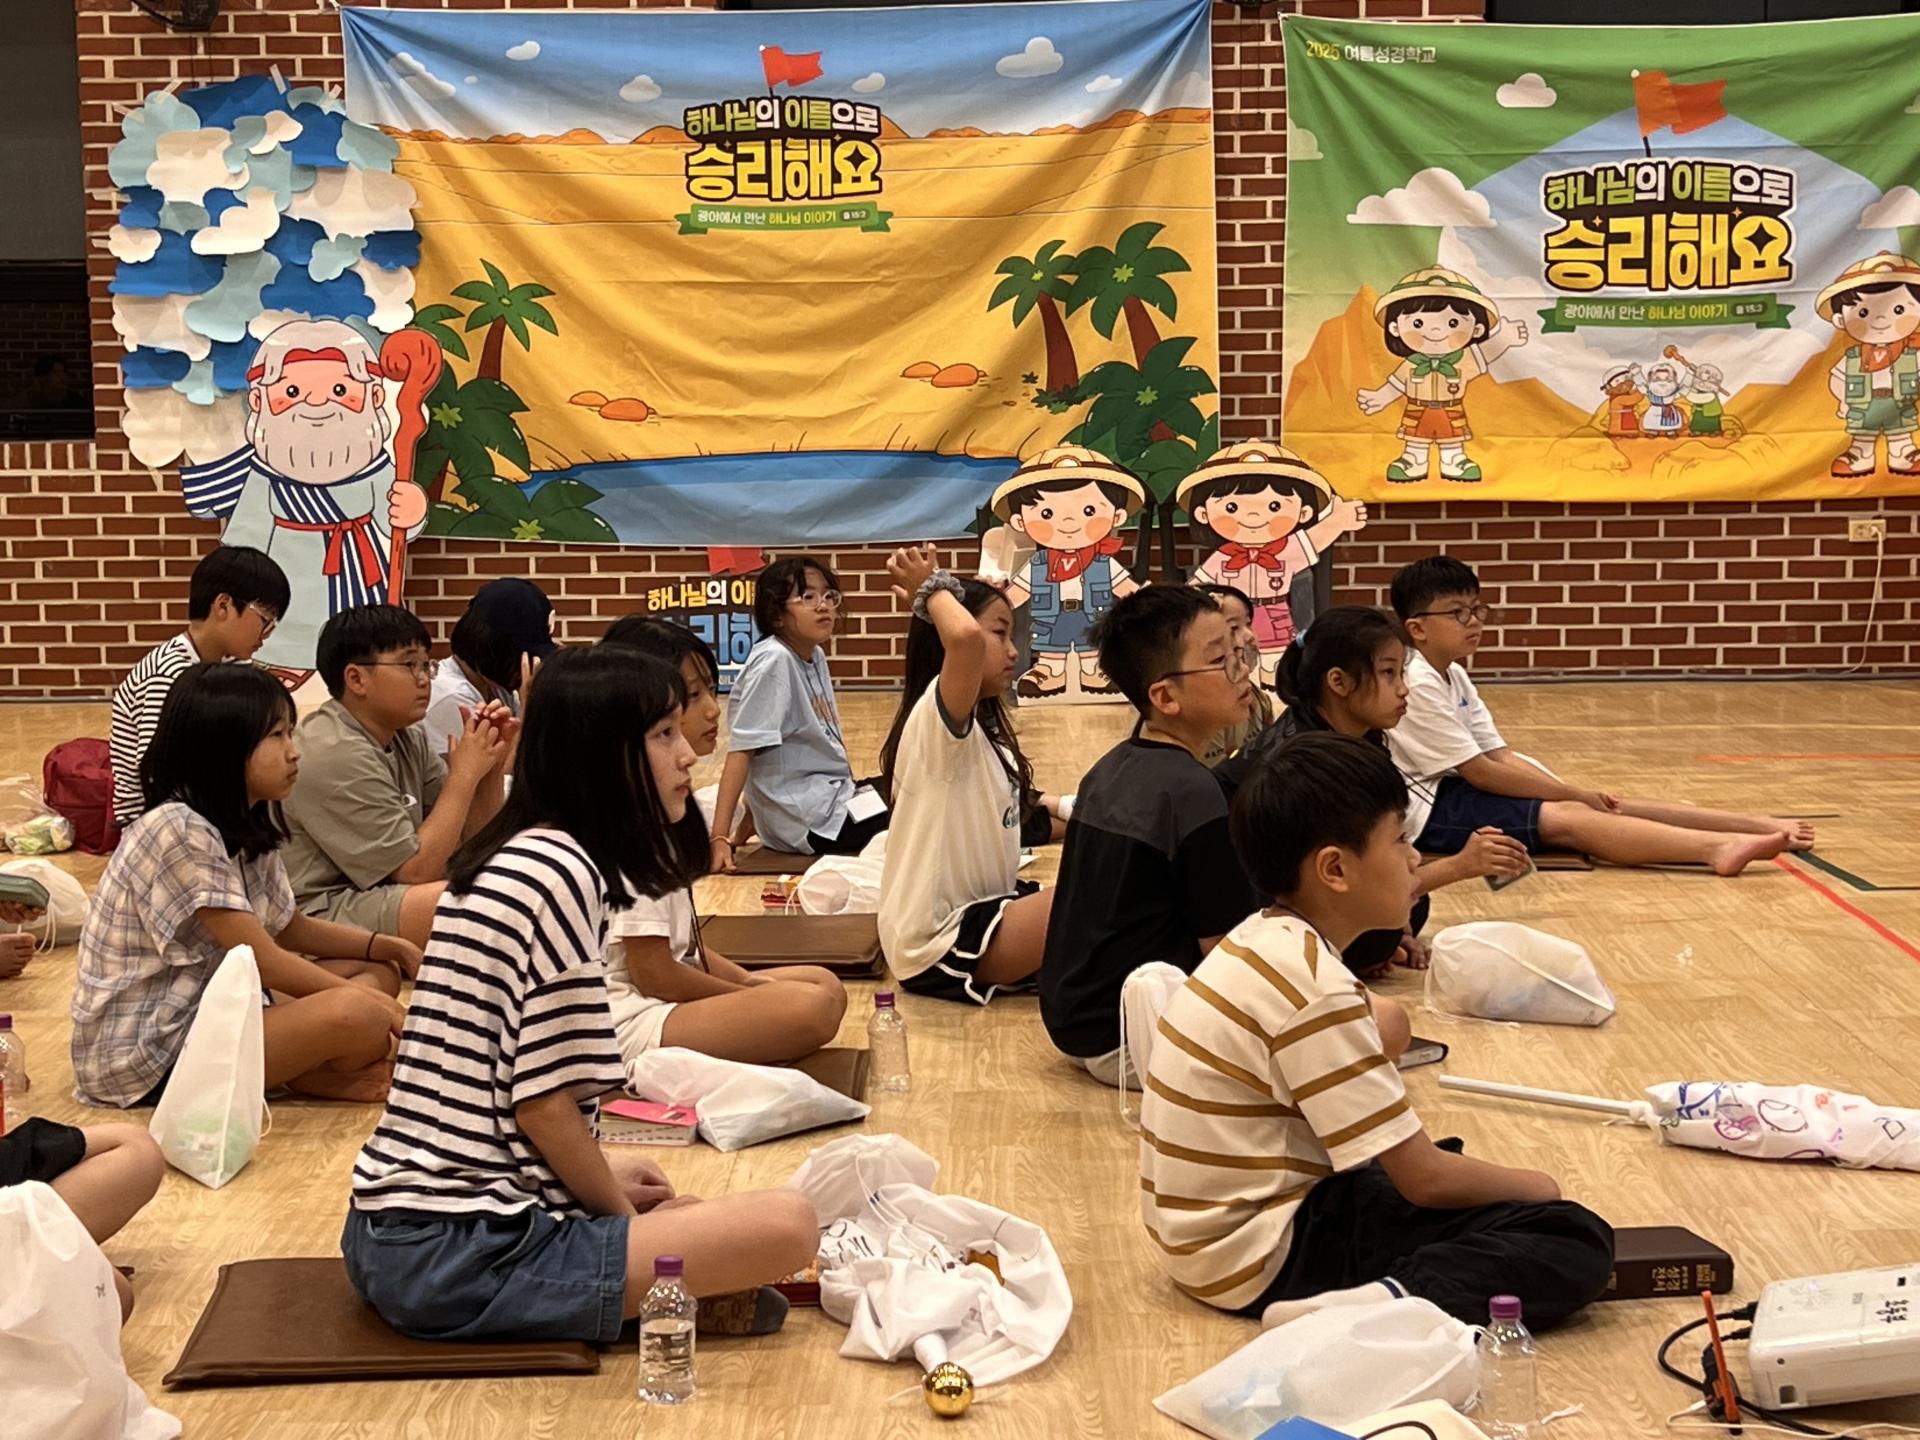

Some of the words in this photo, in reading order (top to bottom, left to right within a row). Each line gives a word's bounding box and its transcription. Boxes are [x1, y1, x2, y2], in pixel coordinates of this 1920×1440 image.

[1306, 40, 1340, 61] 2025
[1344, 45, 1437, 63] 여름성경학교
[686, 98, 780, 136] 하나님의
[784, 98, 879, 134] 이름으로
[688, 138, 880, 199] 승리해요
[1547, 163, 1665, 211] 하나님의
[1672, 163, 1790, 206] 이름으로
[697, 209, 741, 224] 광야에서
[744, 212, 766, 225] 만난
[768, 211, 801, 225] 하나님
[803, 210, 836, 224] 이야기
[1547, 211, 1790, 290] 승리해요
[1564, 303, 1616, 320] 광야에서
[1619, 305, 1645, 320] 만난
[1648, 304, 1686, 320] 하나님
[1689, 303, 1728, 319] 이야기
[1873, 351, 1888, 363] V
[1061, 557, 1077, 571] V
[648, 580, 727, 611] 하나님의
